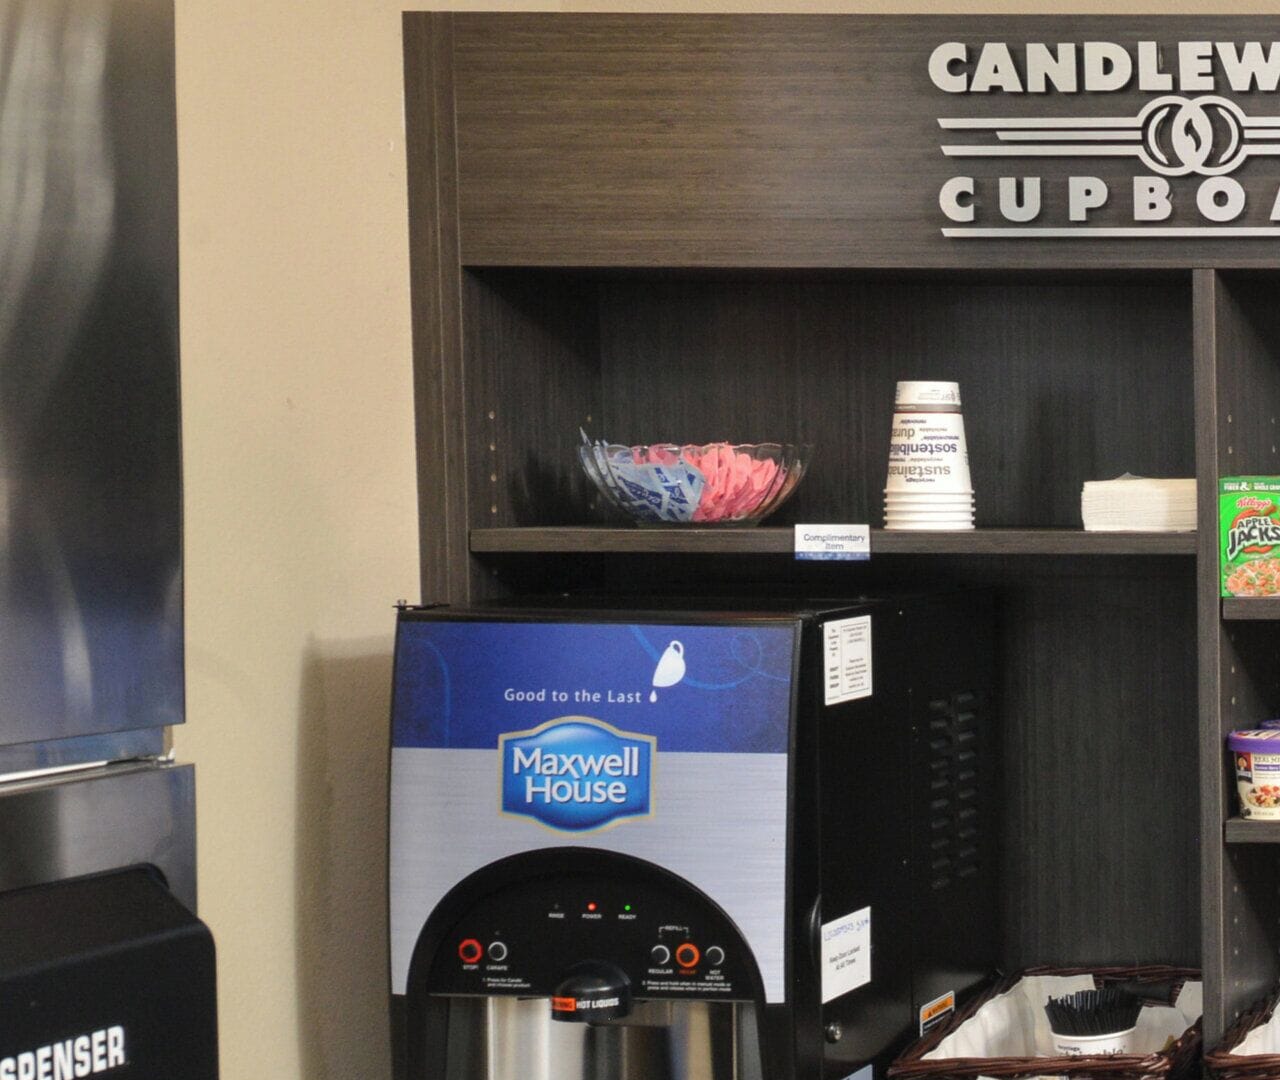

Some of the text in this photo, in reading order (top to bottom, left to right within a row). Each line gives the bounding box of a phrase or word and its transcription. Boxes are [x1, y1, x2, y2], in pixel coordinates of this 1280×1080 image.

[1237, 516, 1271, 529] APPLE
[803, 534, 865, 544] Complimentary
[504, 689, 642, 704] Good to the Last
[513, 747, 640, 777] Maxwell
[525, 776, 627, 804] House
